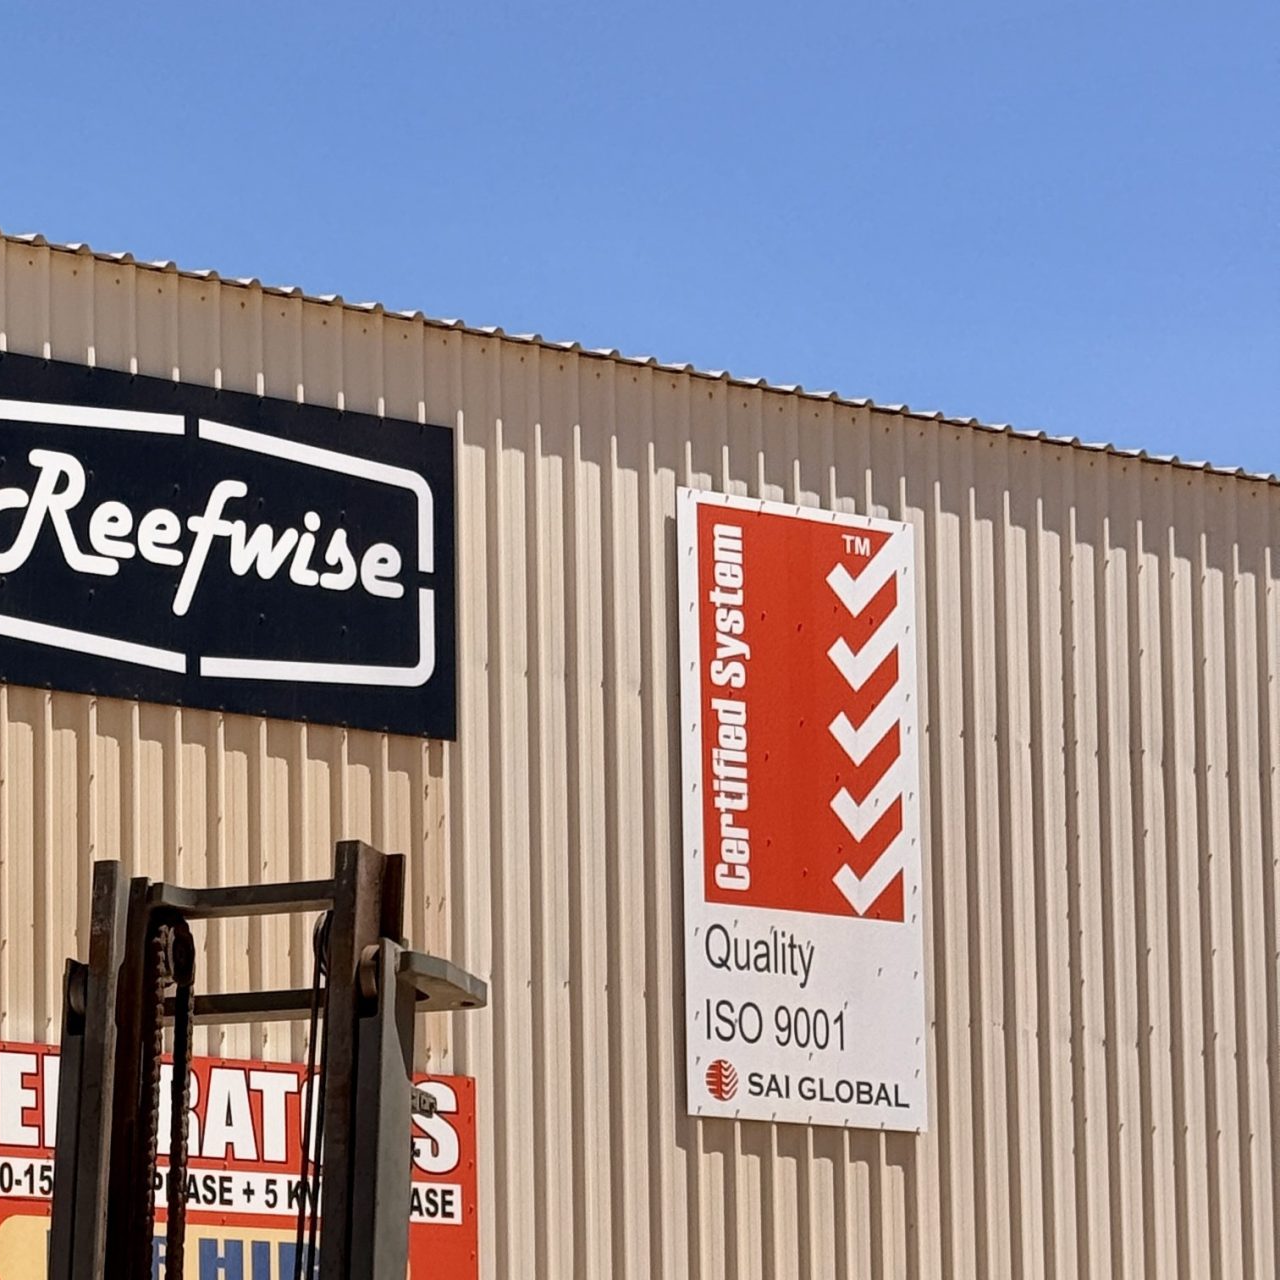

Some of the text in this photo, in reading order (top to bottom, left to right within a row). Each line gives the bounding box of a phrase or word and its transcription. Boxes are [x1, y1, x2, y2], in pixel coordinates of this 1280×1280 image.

[841, 534, 871, 557] TM
[709, 523, 751, 891] Certified System
[705, 923, 815, 989] Quality
[705, 998, 845, 1051] ISO 9001
[747, 1072, 911, 1109] SAI GLOBAL
[242, 1180, 255, 1204] +
[264, 1178, 278, 1209] 5
